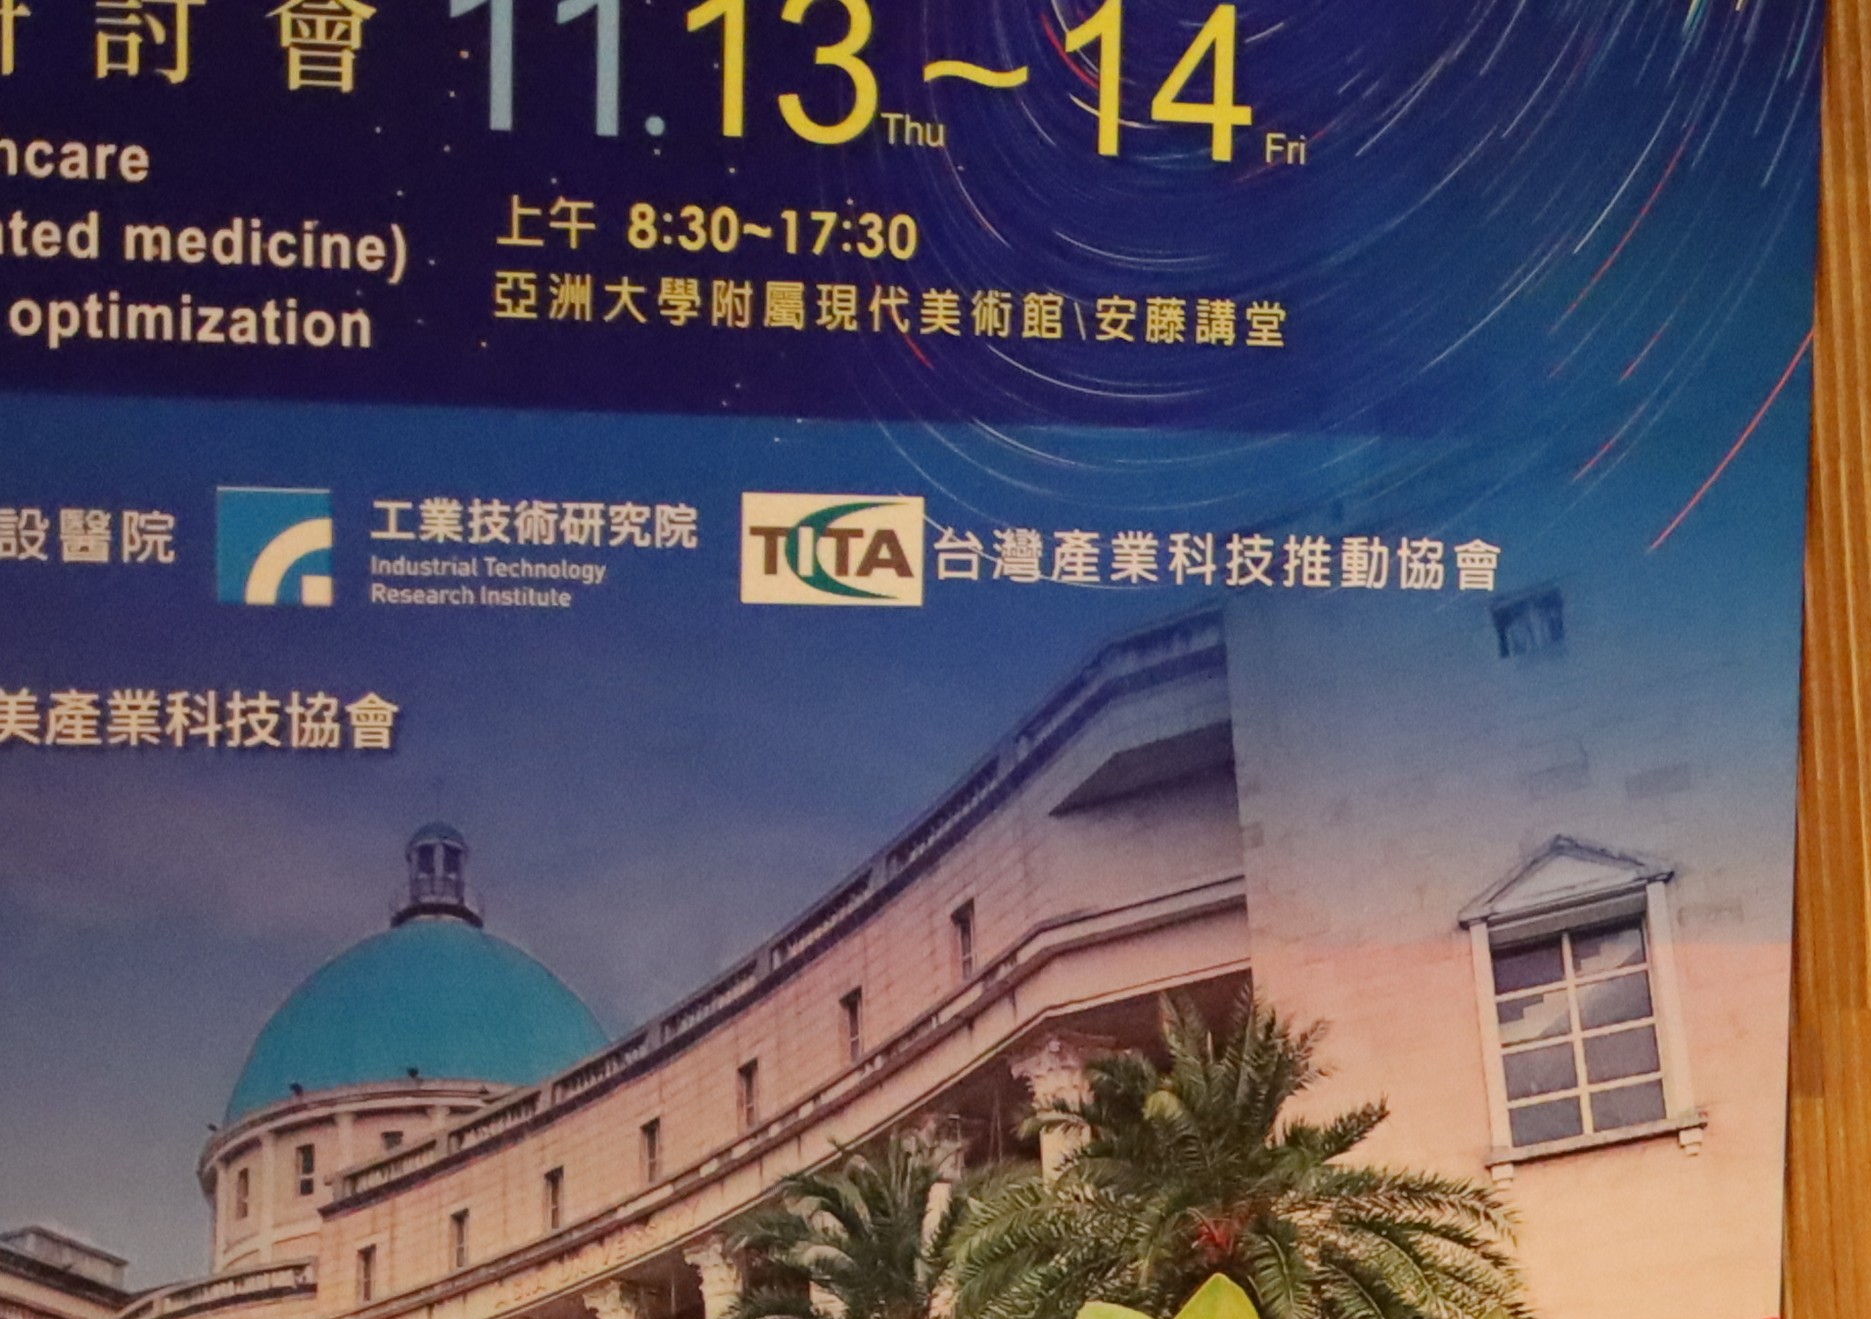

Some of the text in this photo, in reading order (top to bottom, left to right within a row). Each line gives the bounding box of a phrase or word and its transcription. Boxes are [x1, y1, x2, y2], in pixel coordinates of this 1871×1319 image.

[881, 112, 945, 148] Thu
[1264, 132, 1307, 165] Fri
[0, 210, 407, 285] ted medicine)
[496, 195, 918, 261] 上午 8:30~17:30
[9, 290, 372, 350] optimization
[370, 496, 698, 549] 工業技術研究院
[371, 555, 607, 585] Industrial Technology
[932, 526, 1502, 592] 台灣產業科技推動協會
[371, 583, 572, 608] Research Institute
